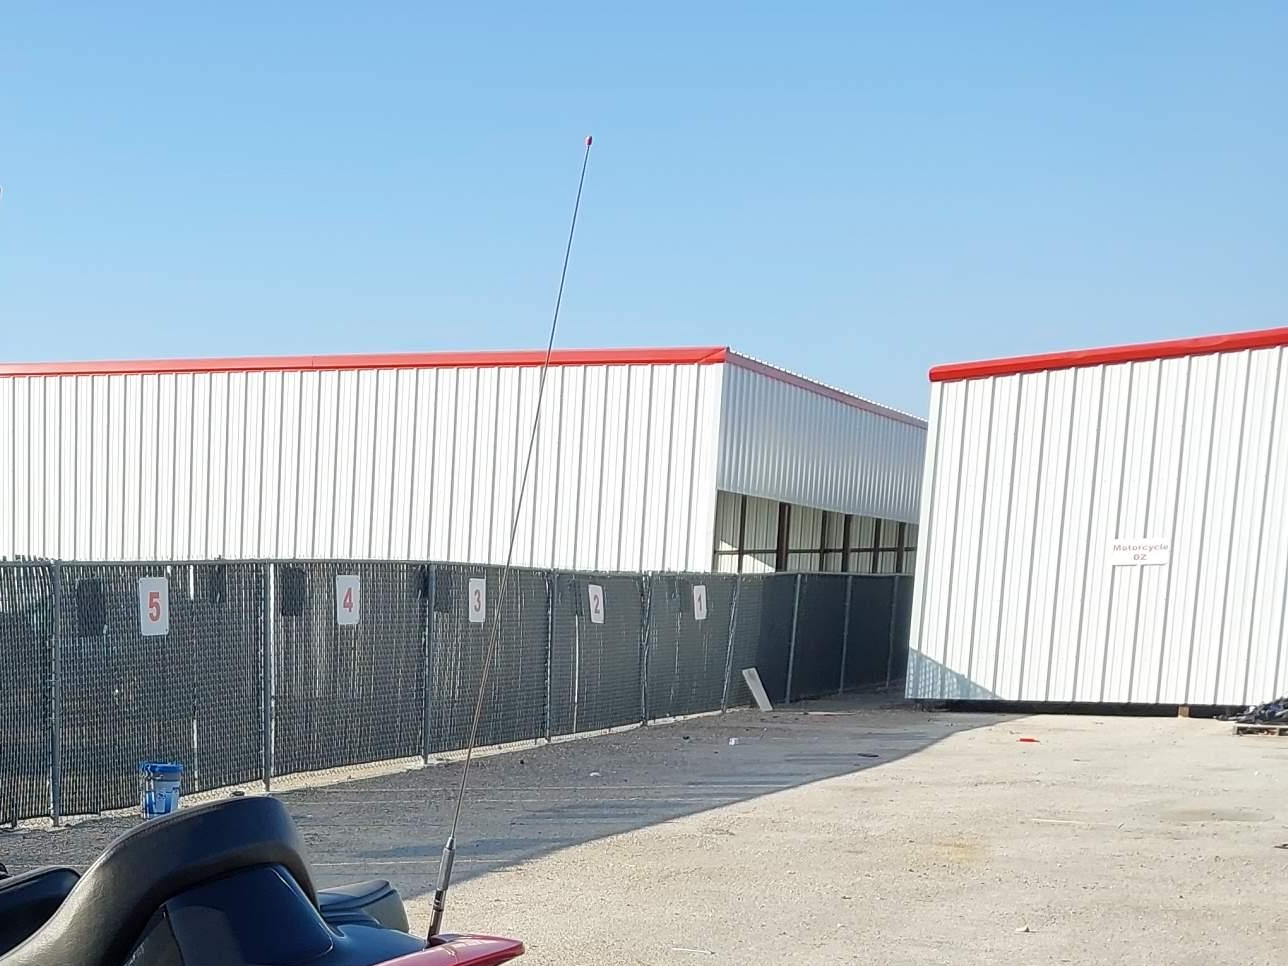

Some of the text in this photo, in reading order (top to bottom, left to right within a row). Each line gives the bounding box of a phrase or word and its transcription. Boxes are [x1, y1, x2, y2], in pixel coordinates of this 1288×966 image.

[1113, 544, 1169, 552] Motorcycle
[148, 591, 161, 622] 5
[343, 587, 353, 612] 4
[474, 589, 481, 612] 3
[593, 594, 600, 614] 2
[697, 593, 703, 612] 1
